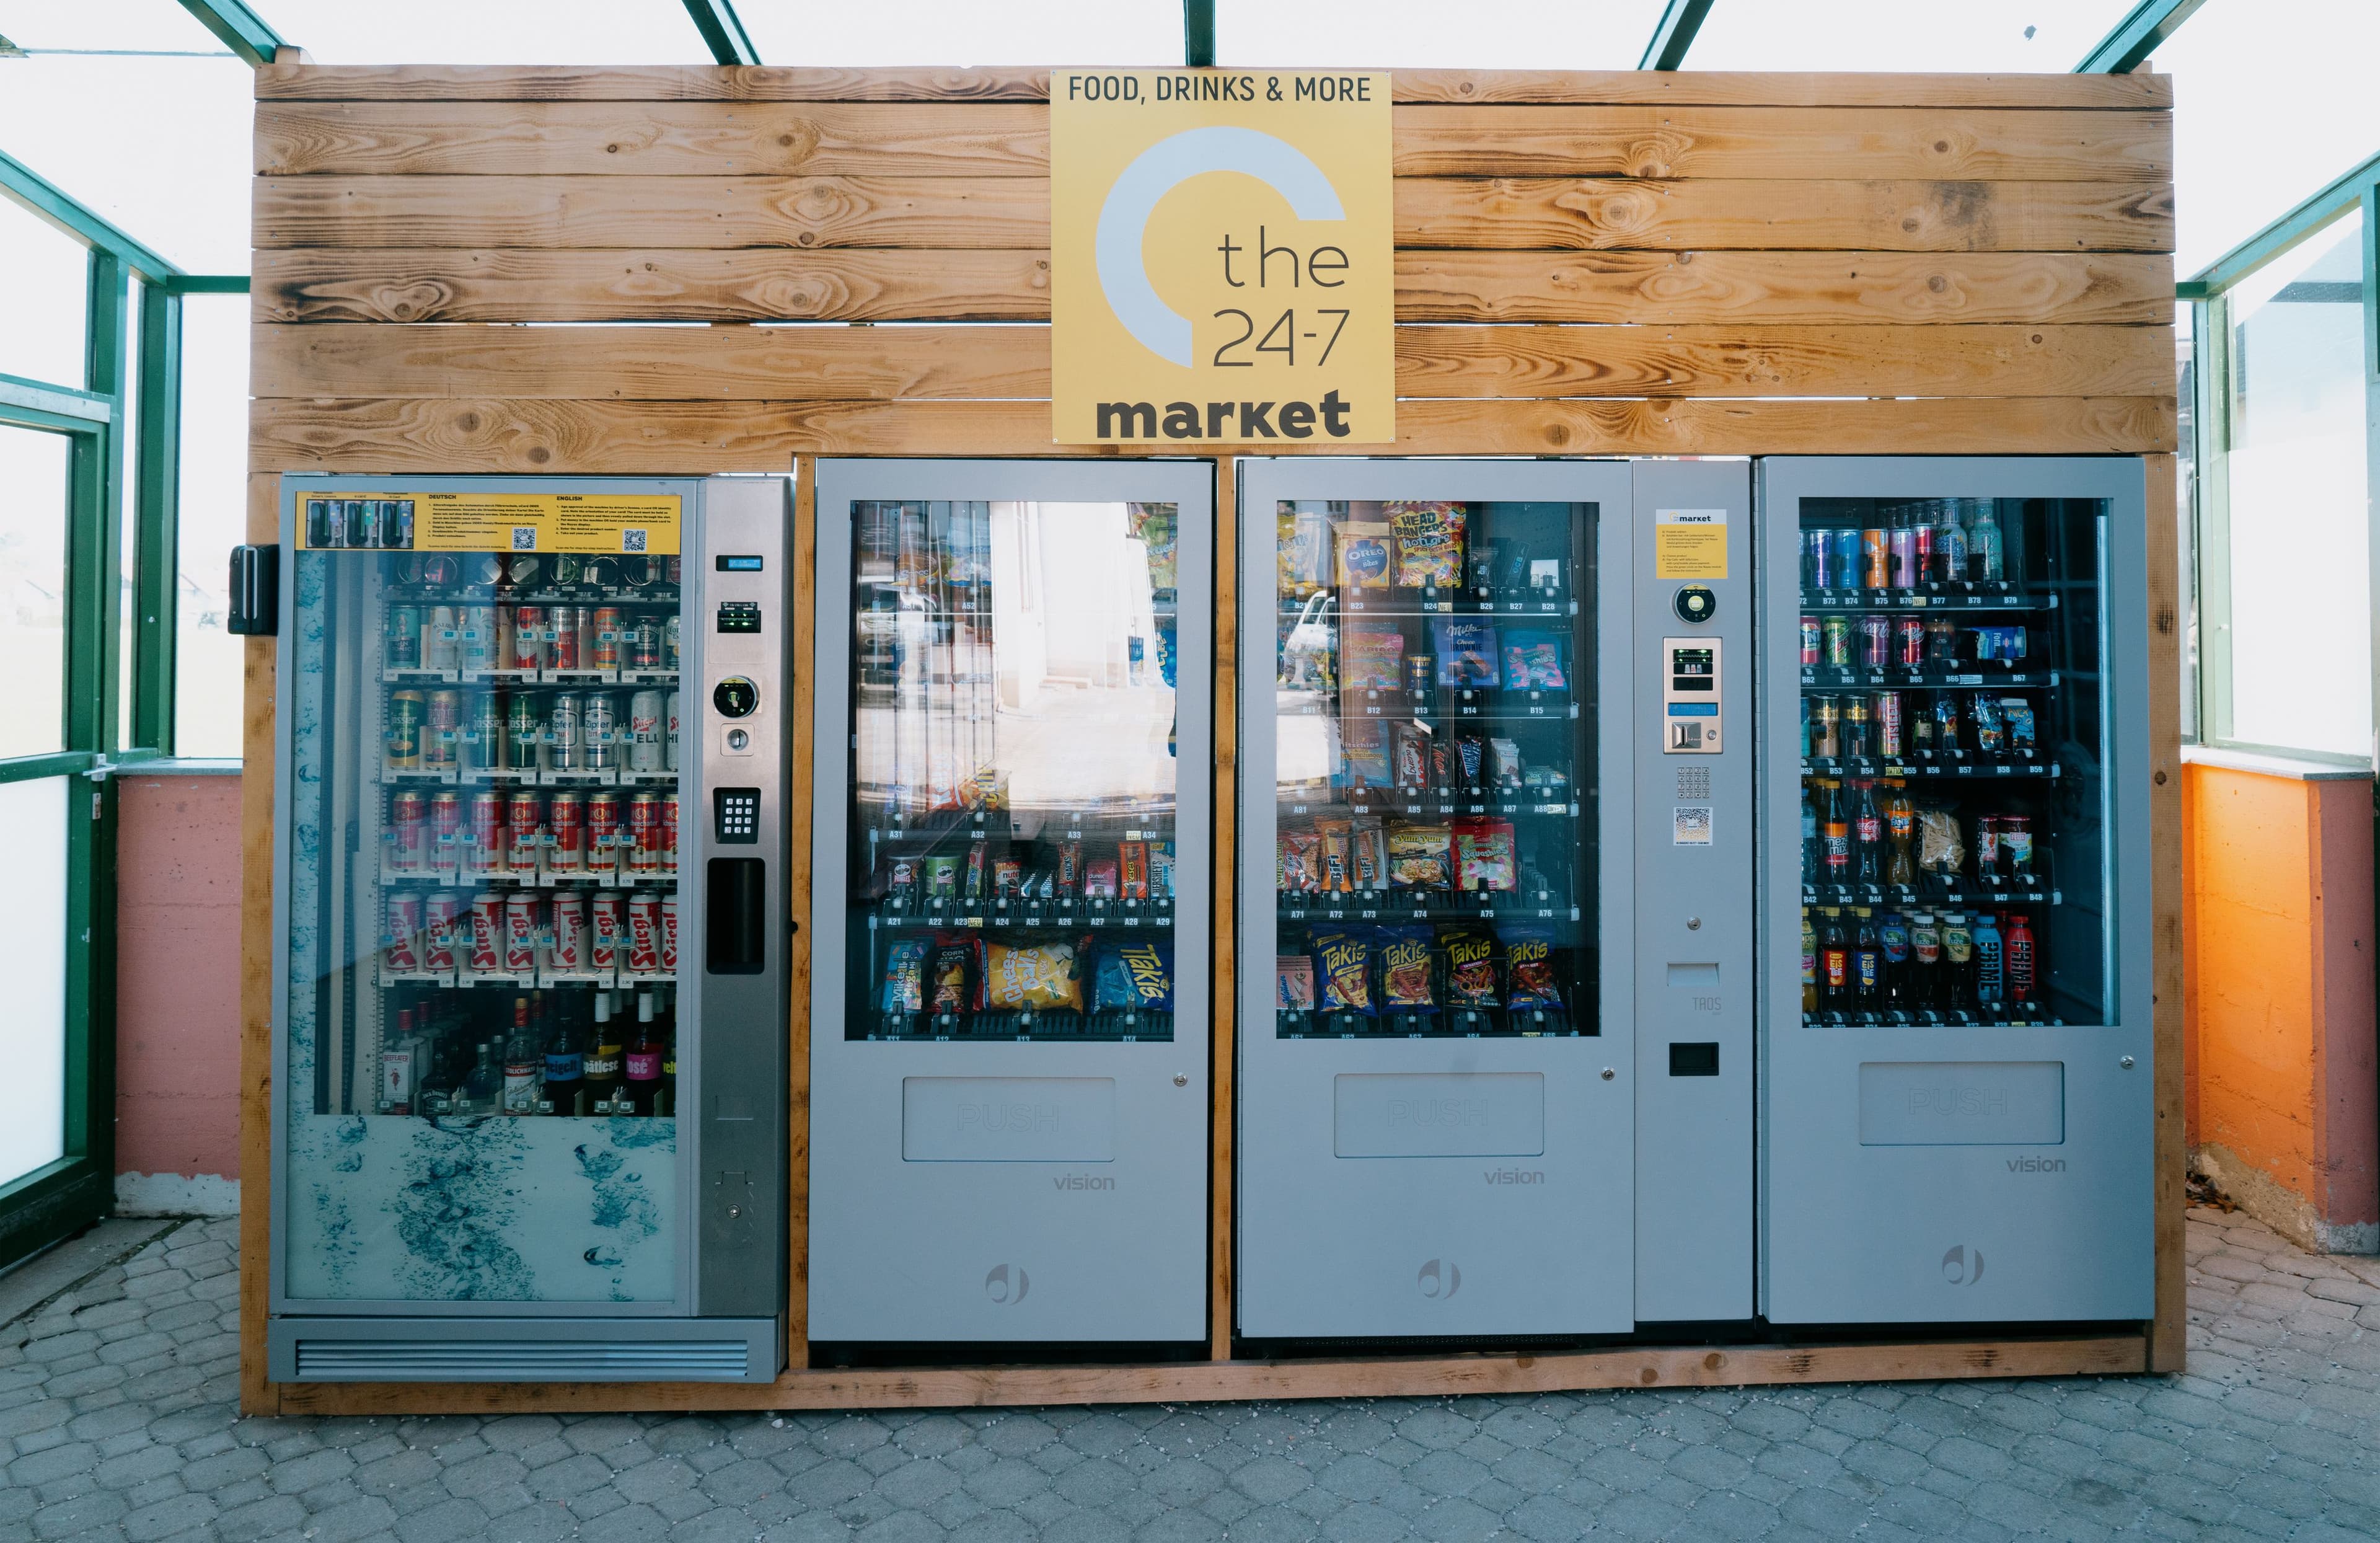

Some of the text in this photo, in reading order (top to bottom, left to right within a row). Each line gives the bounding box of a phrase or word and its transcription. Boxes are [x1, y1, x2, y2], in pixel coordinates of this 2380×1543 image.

[1069, 76, 1371, 104] FOOD, DRINKS & MORE
[1217, 225, 1349, 288] the
[1213, 308, 1350, 367] 24-7
[1096, 389, 1351, 438] market
[1401, 512, 1437, 527] HEAD
[1348, 547, 1384, 560] OREO
[1395, 834, 1442, 844] Yum Yum
[1829, 845, 1847, 854] mix
[1461, 847, 1509, 860] Squashies
[937, 875, 953, 883] PRINGLES
[1066, 856, 1074, 880] SNACKS
[1152, 860, 1163, 893] HERSHEY'S
[630, 913, 656, 966] Stiegl
[1321, 943, 1367, 976] Takis
[1382, 942, 1426, 972] Takis
[1447, 940, 1491, 971] Takis
[1980, 942, 1999, 990] PRIME
[1120, 944, 1166, 999] Takis
[1387, 1099, 1488, 1126] PUSH
[1908, 1087, 2008, 1115] PUSH
[957, 1103, 1059, 1131] PUSH
[1484, 1168, 1545, 1185] vision
[2006, 1156, 2066, 1172] vision
[1054, 1174, 1114, 1190] vision
